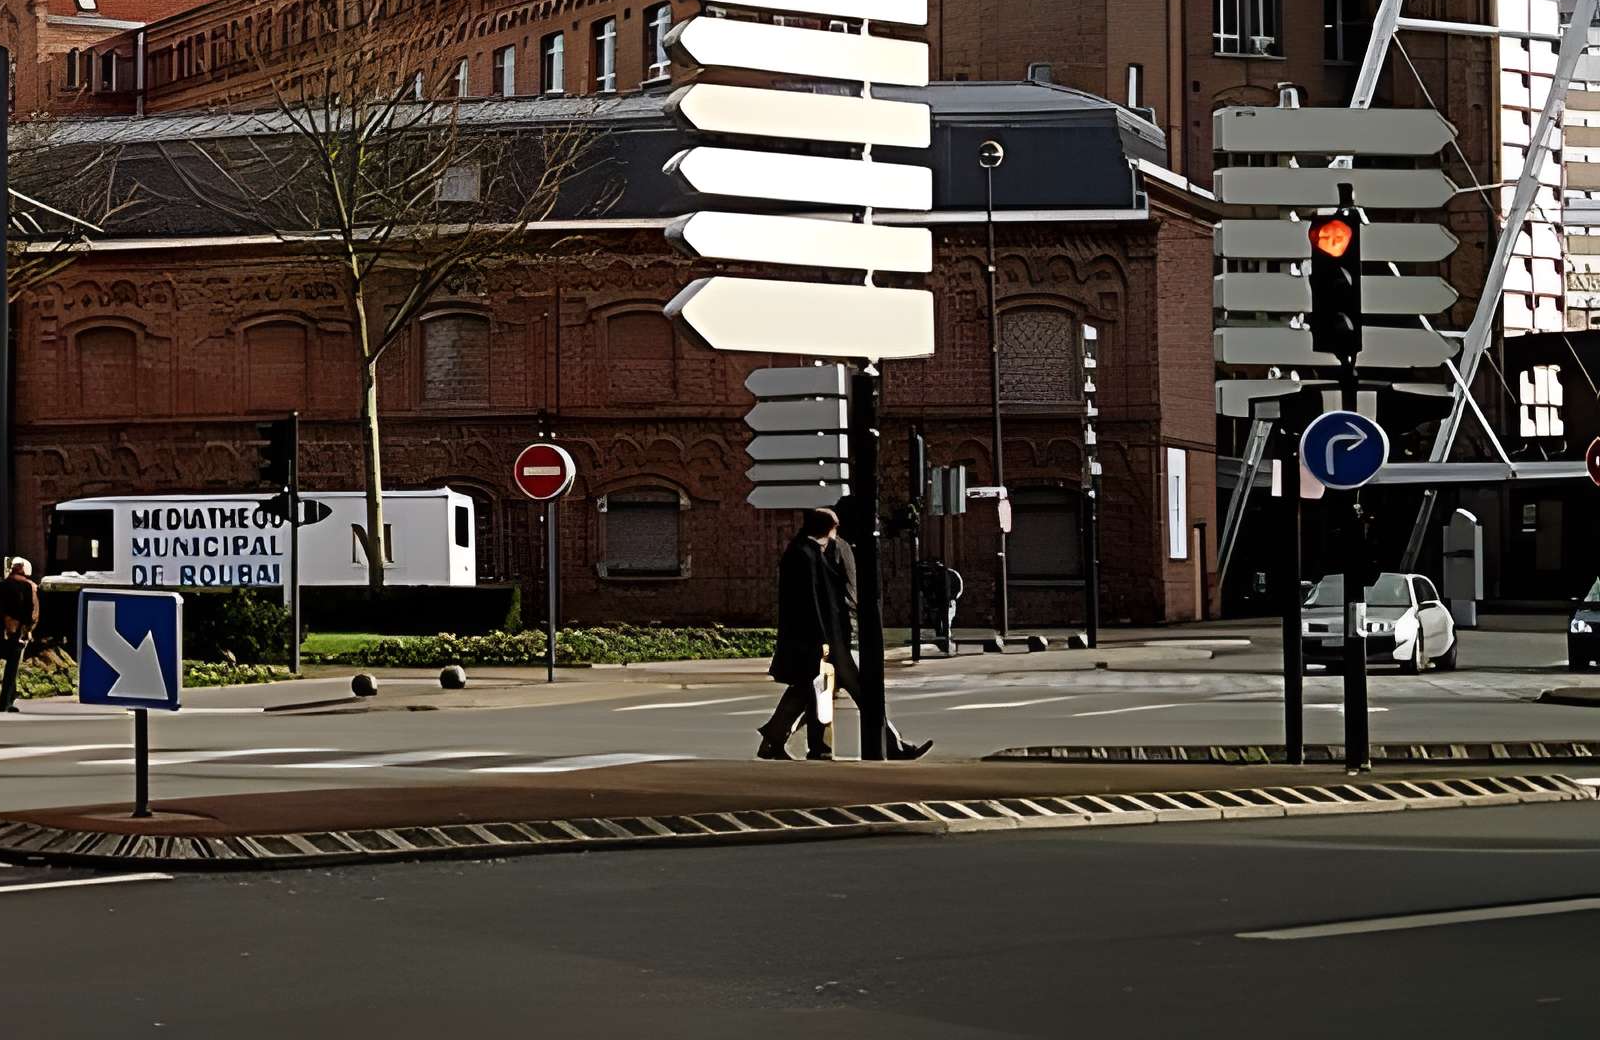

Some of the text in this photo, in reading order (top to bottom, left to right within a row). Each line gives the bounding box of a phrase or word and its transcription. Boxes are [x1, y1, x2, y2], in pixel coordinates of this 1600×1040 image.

[132, 507, 284, 530] MEDIATHEQU
[132, 536, 283, 557] MUNICIPAL
[180, 564, 280, 585] ROUBAI
